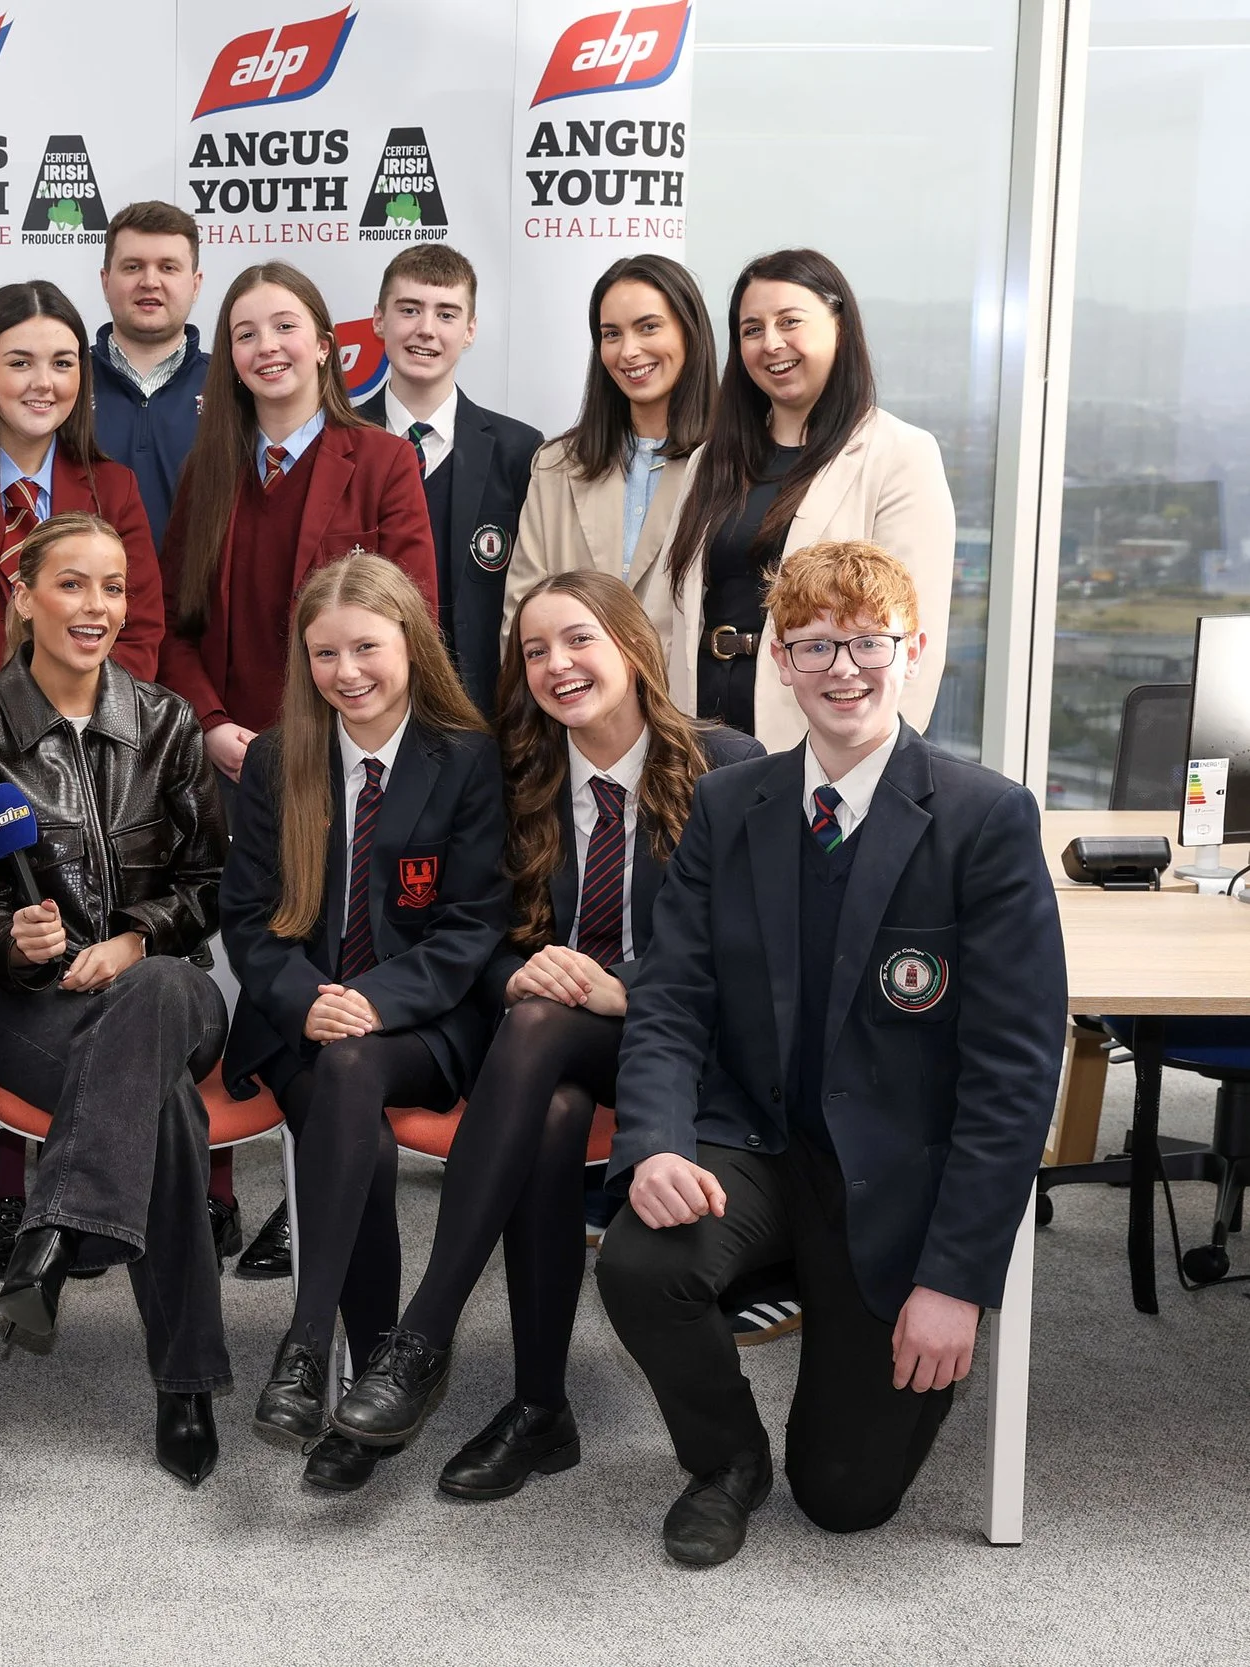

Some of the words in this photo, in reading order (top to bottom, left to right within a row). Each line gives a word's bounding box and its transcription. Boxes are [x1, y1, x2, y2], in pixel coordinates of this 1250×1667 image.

[572, 9, 659, 84] abp
[229, 26, 309, 98] abp
[189, 129, 349, 168] ANGUS
[526, 120, 686, 158] ANGUS
[45, 152, 87, 164] CERTIFIED
[385, 145, 427, 157] CERTIFIED
[44, 164, 88, 181] IRISH
[383, 157, 427, 175] IRISH
[36, 180, 96, 200] ANGUS
[375, 174, 434, 194] ANGUS
[526, 169, 684, 207] YOUTH
[189, 176, 349, 214] YOUTH
[359, 229, 411, 241] PRODUCER
[414, 228, 448, 240] GROUP
[525, 218, 683, 239] CHALLENGE
[22, 233, 75, 245] PRODUCER
[901, 947, 925, 956] College
